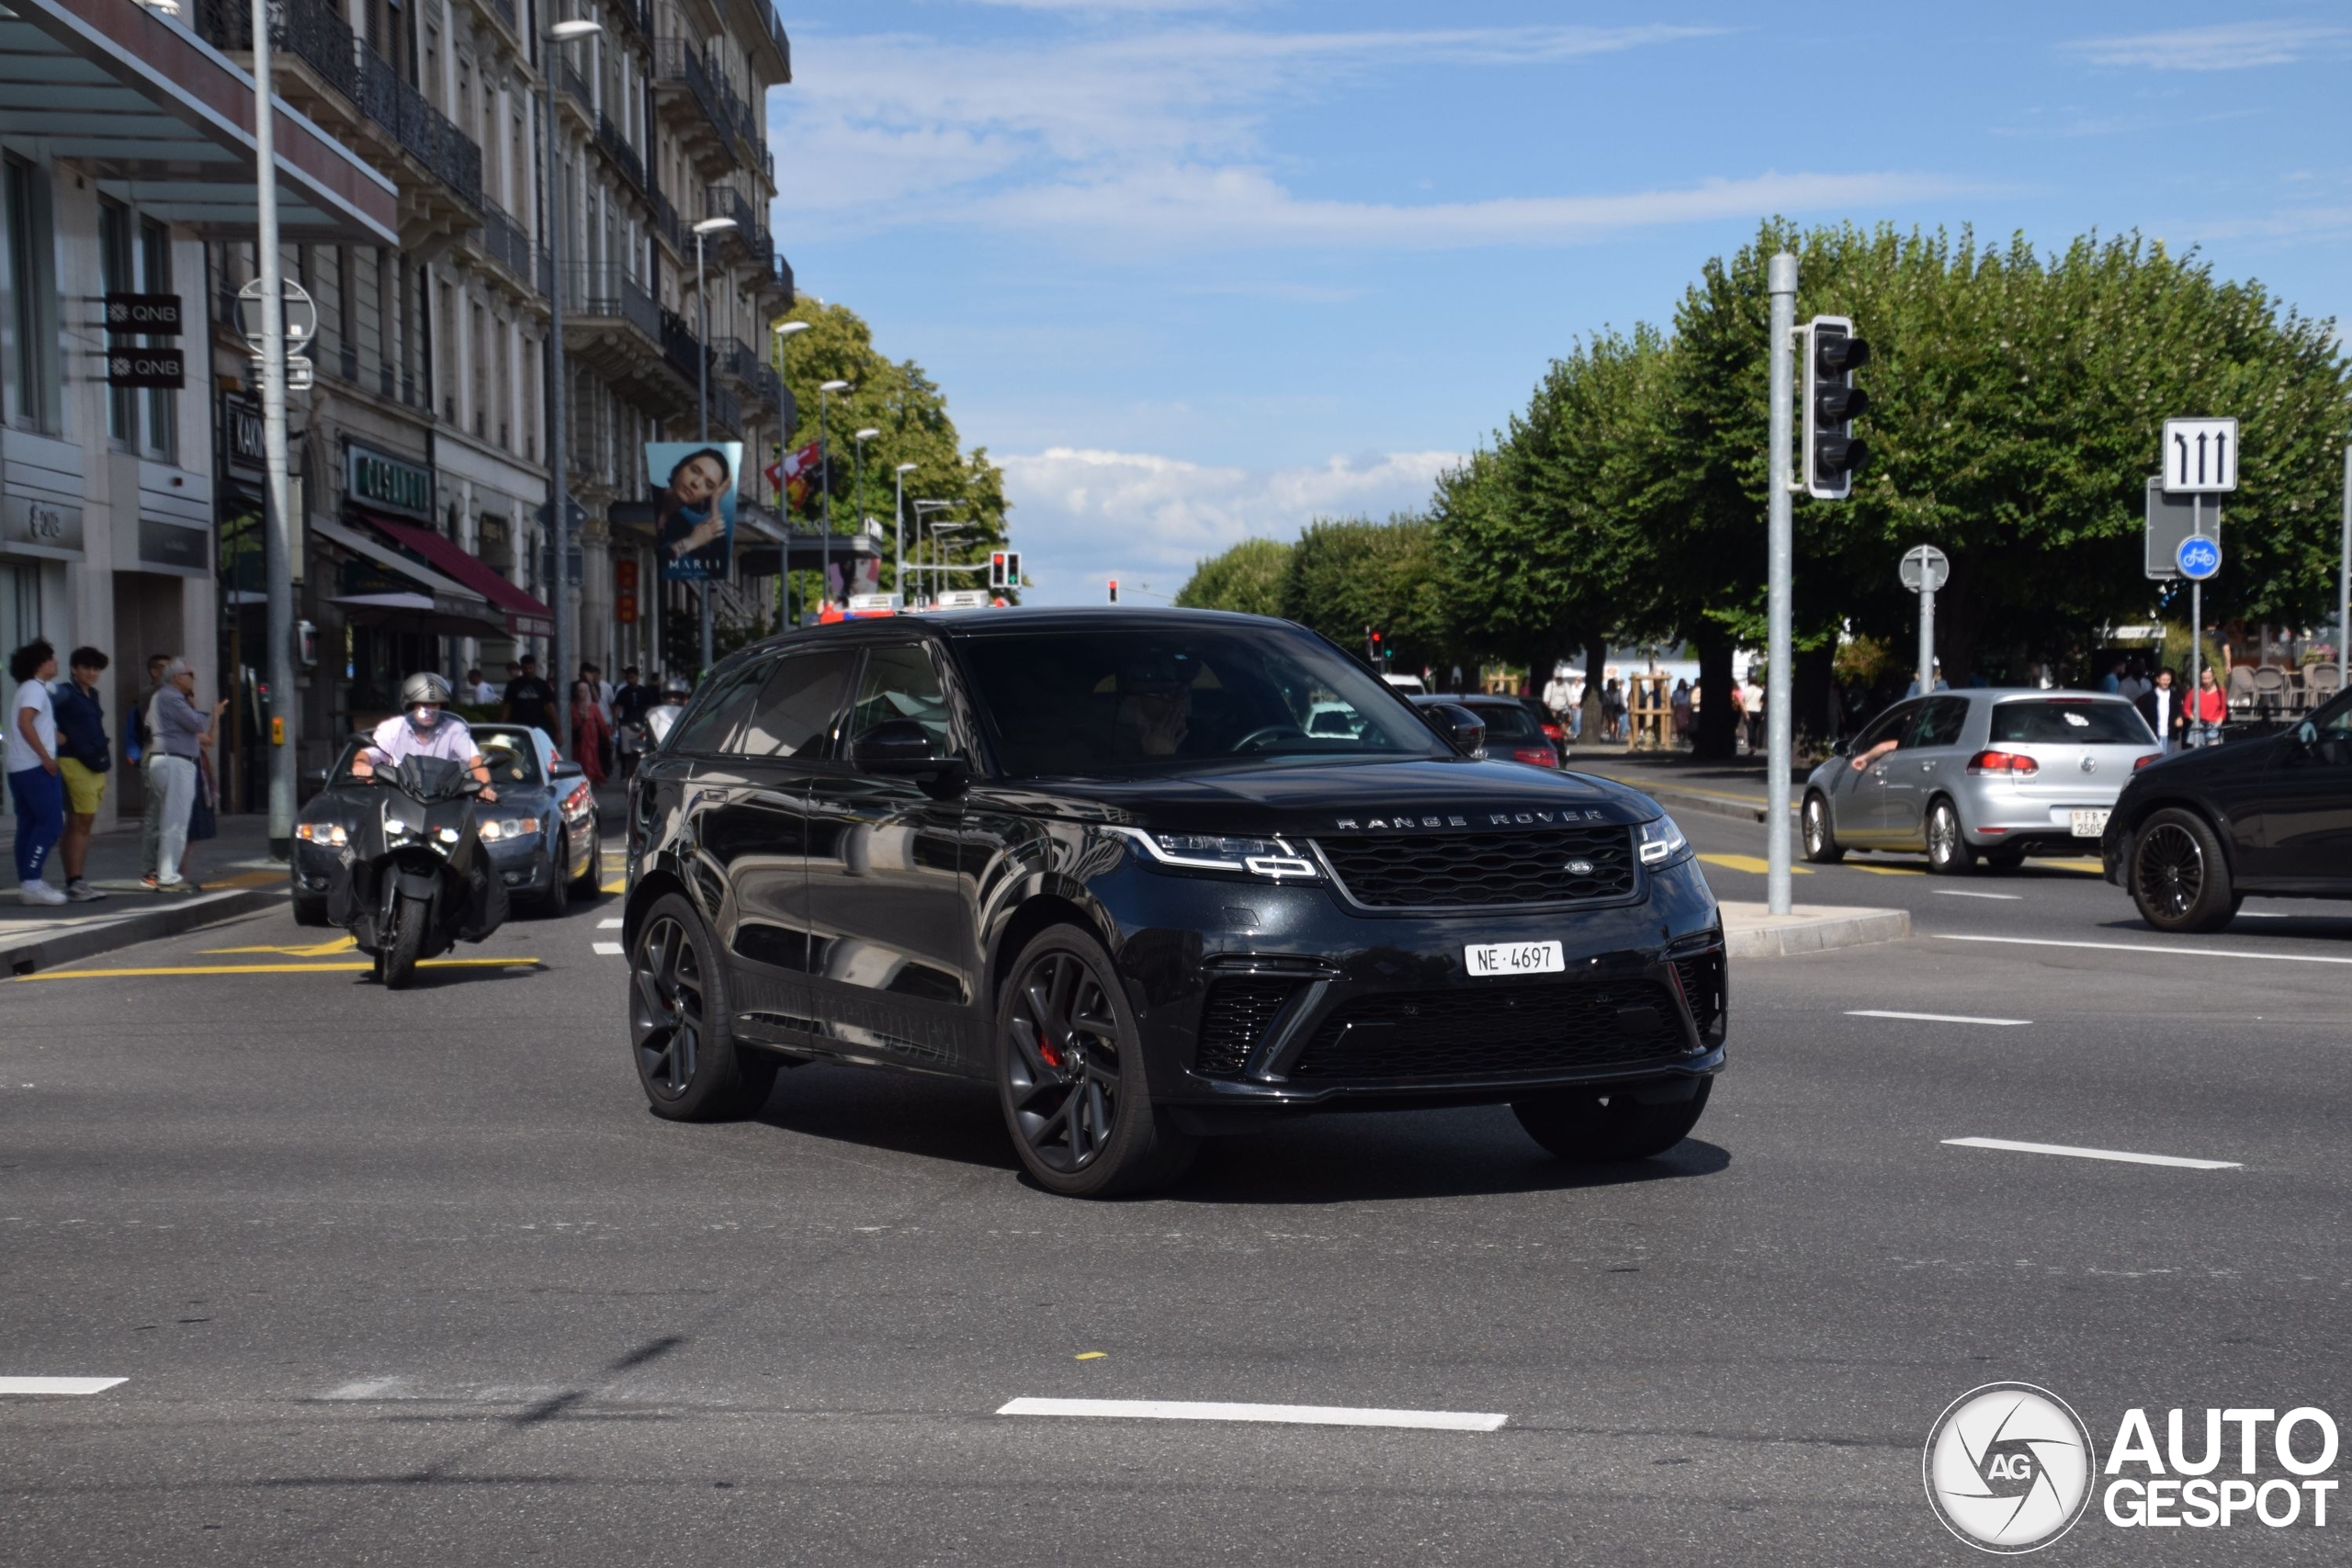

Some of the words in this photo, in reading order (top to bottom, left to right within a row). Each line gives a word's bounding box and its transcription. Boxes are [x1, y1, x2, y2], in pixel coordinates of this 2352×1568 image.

[132, 306, 176, 321] QNB
[135, 360, 179, 375] QNB
[1336, 816, 1467, 829] RANGE
[1489, 809, 1604, 825] ROVER
[2085, 812, 2098, 823] FR
[1476, 949, 1499, 971] NE
[1510, 946, 1551, 969] 4697
